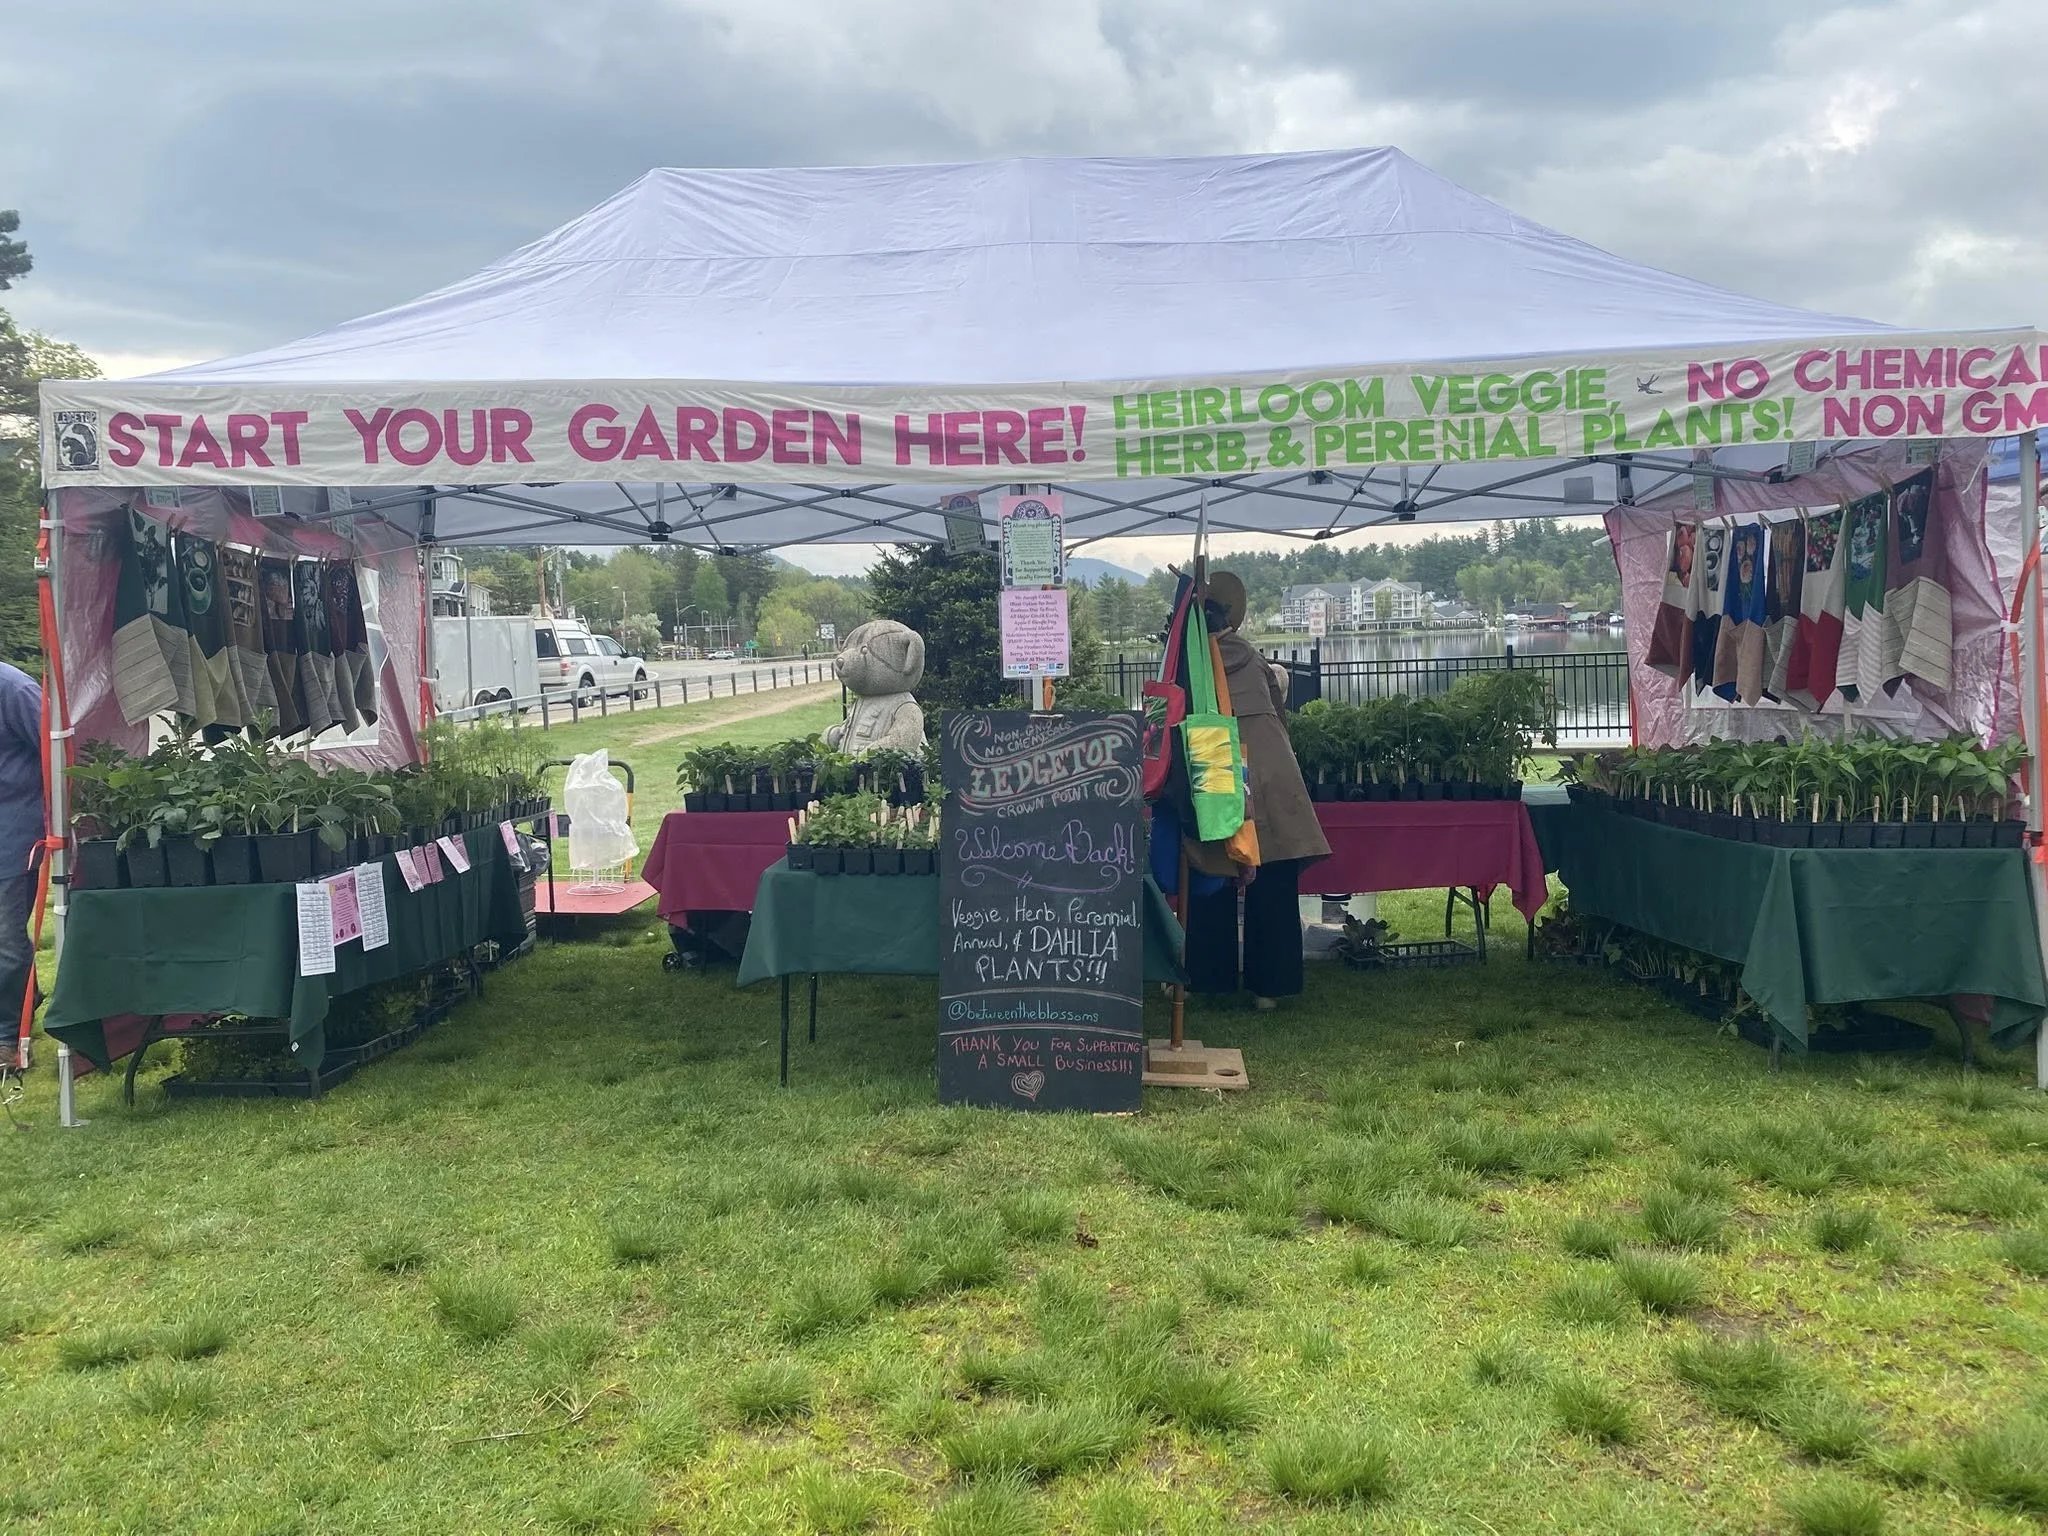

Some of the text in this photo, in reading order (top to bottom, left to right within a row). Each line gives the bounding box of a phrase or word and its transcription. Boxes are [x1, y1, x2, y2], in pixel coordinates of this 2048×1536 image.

[1687, 345, 2048, 402] NO CHEMICA
[1113, 368, 1617, 430] HEIRLOOM VEGGIE,
[1823, 394, 1945, 437] NON
[108, 403, 1087, 468] START YOUR GARDEN HERE!
[1114, 430, 1260, 476] HERB,
[1266, 426, 1305, 468] &
[1583, 397, 1794, 455] PLANTS!
[970, 734, 1123, 798] LEDGETOP
[984, 745, 1004, 758] NO
[996, 781, 1090, 818] CROWN POINT
[954, 819, 1136, 875] Welcome Back!
[1030, 925, 1119, 961] DAHLIA
[975, 954, 1109, 984] PLANTS!!!
[947, 999, 1100, 1023] @betweentheblossoms
[950, 1034, 1001, 1056] THANK
[977, 1053, 988, 1071] A
[997, 1053, 1046, 1067] SMALL
